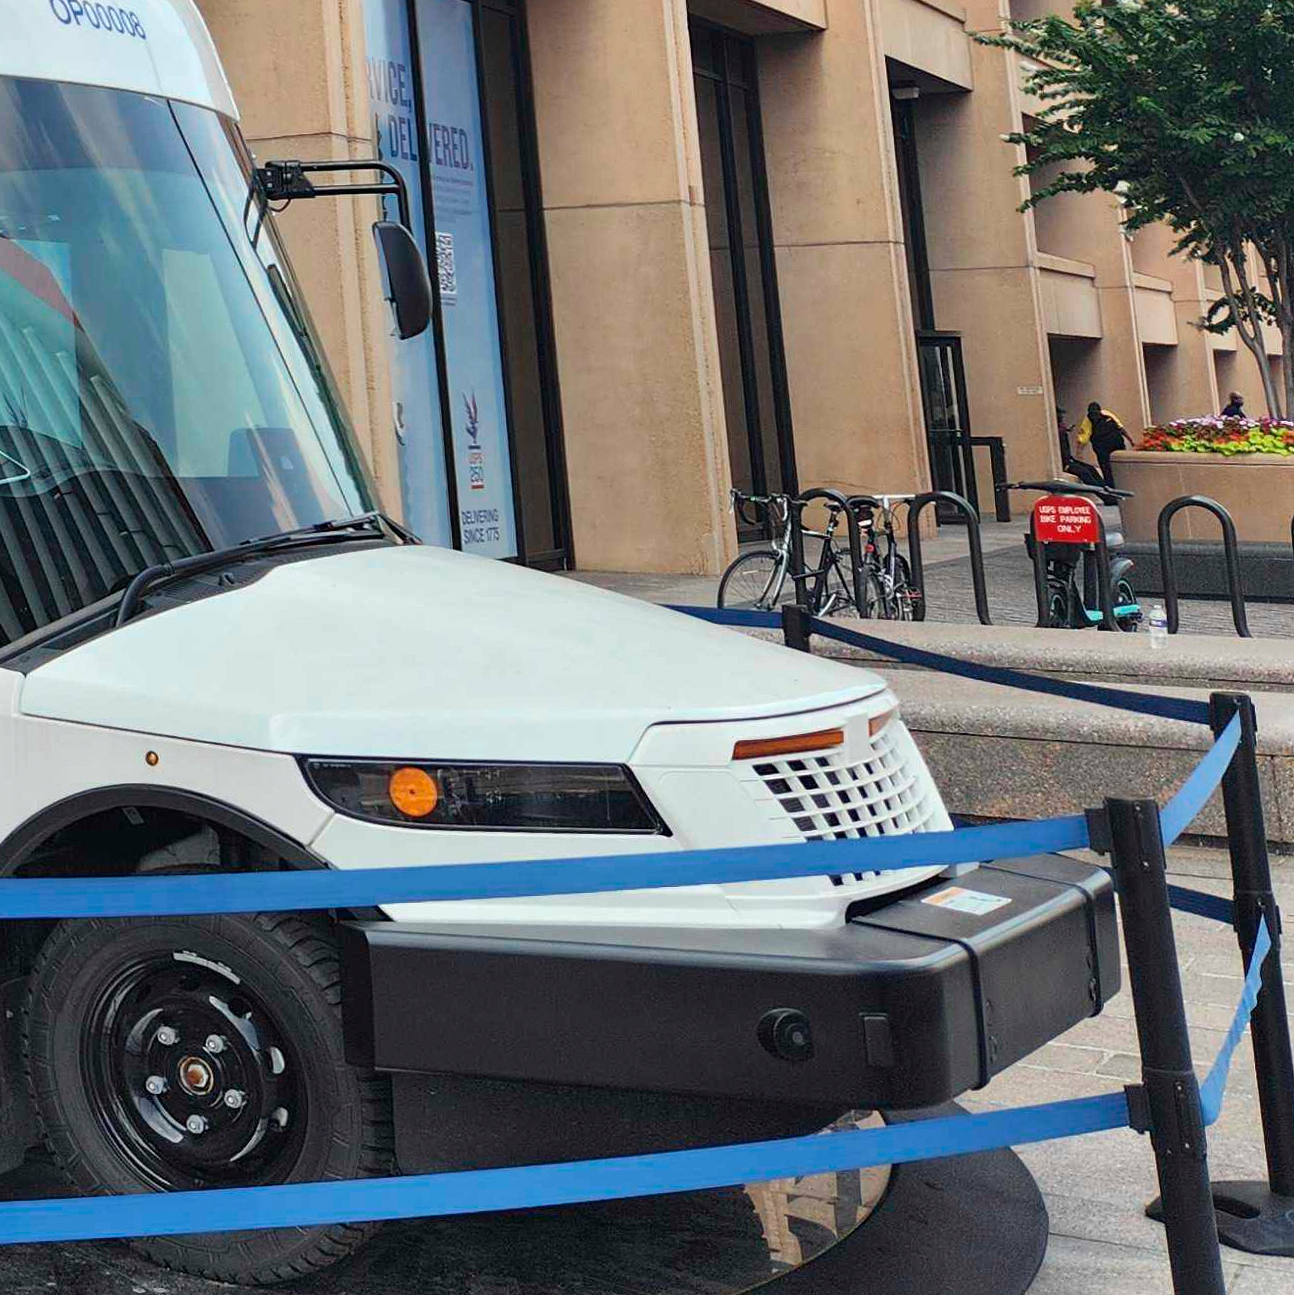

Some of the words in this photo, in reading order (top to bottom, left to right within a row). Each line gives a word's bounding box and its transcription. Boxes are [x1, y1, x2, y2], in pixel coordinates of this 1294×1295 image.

[462, 509, 499, 526] DELIVERING
[1059, 515, 1091, 524] PARKING
[1057, 525, 1082, 534] ONLY
[464, 528, 485, 544] SINCE
